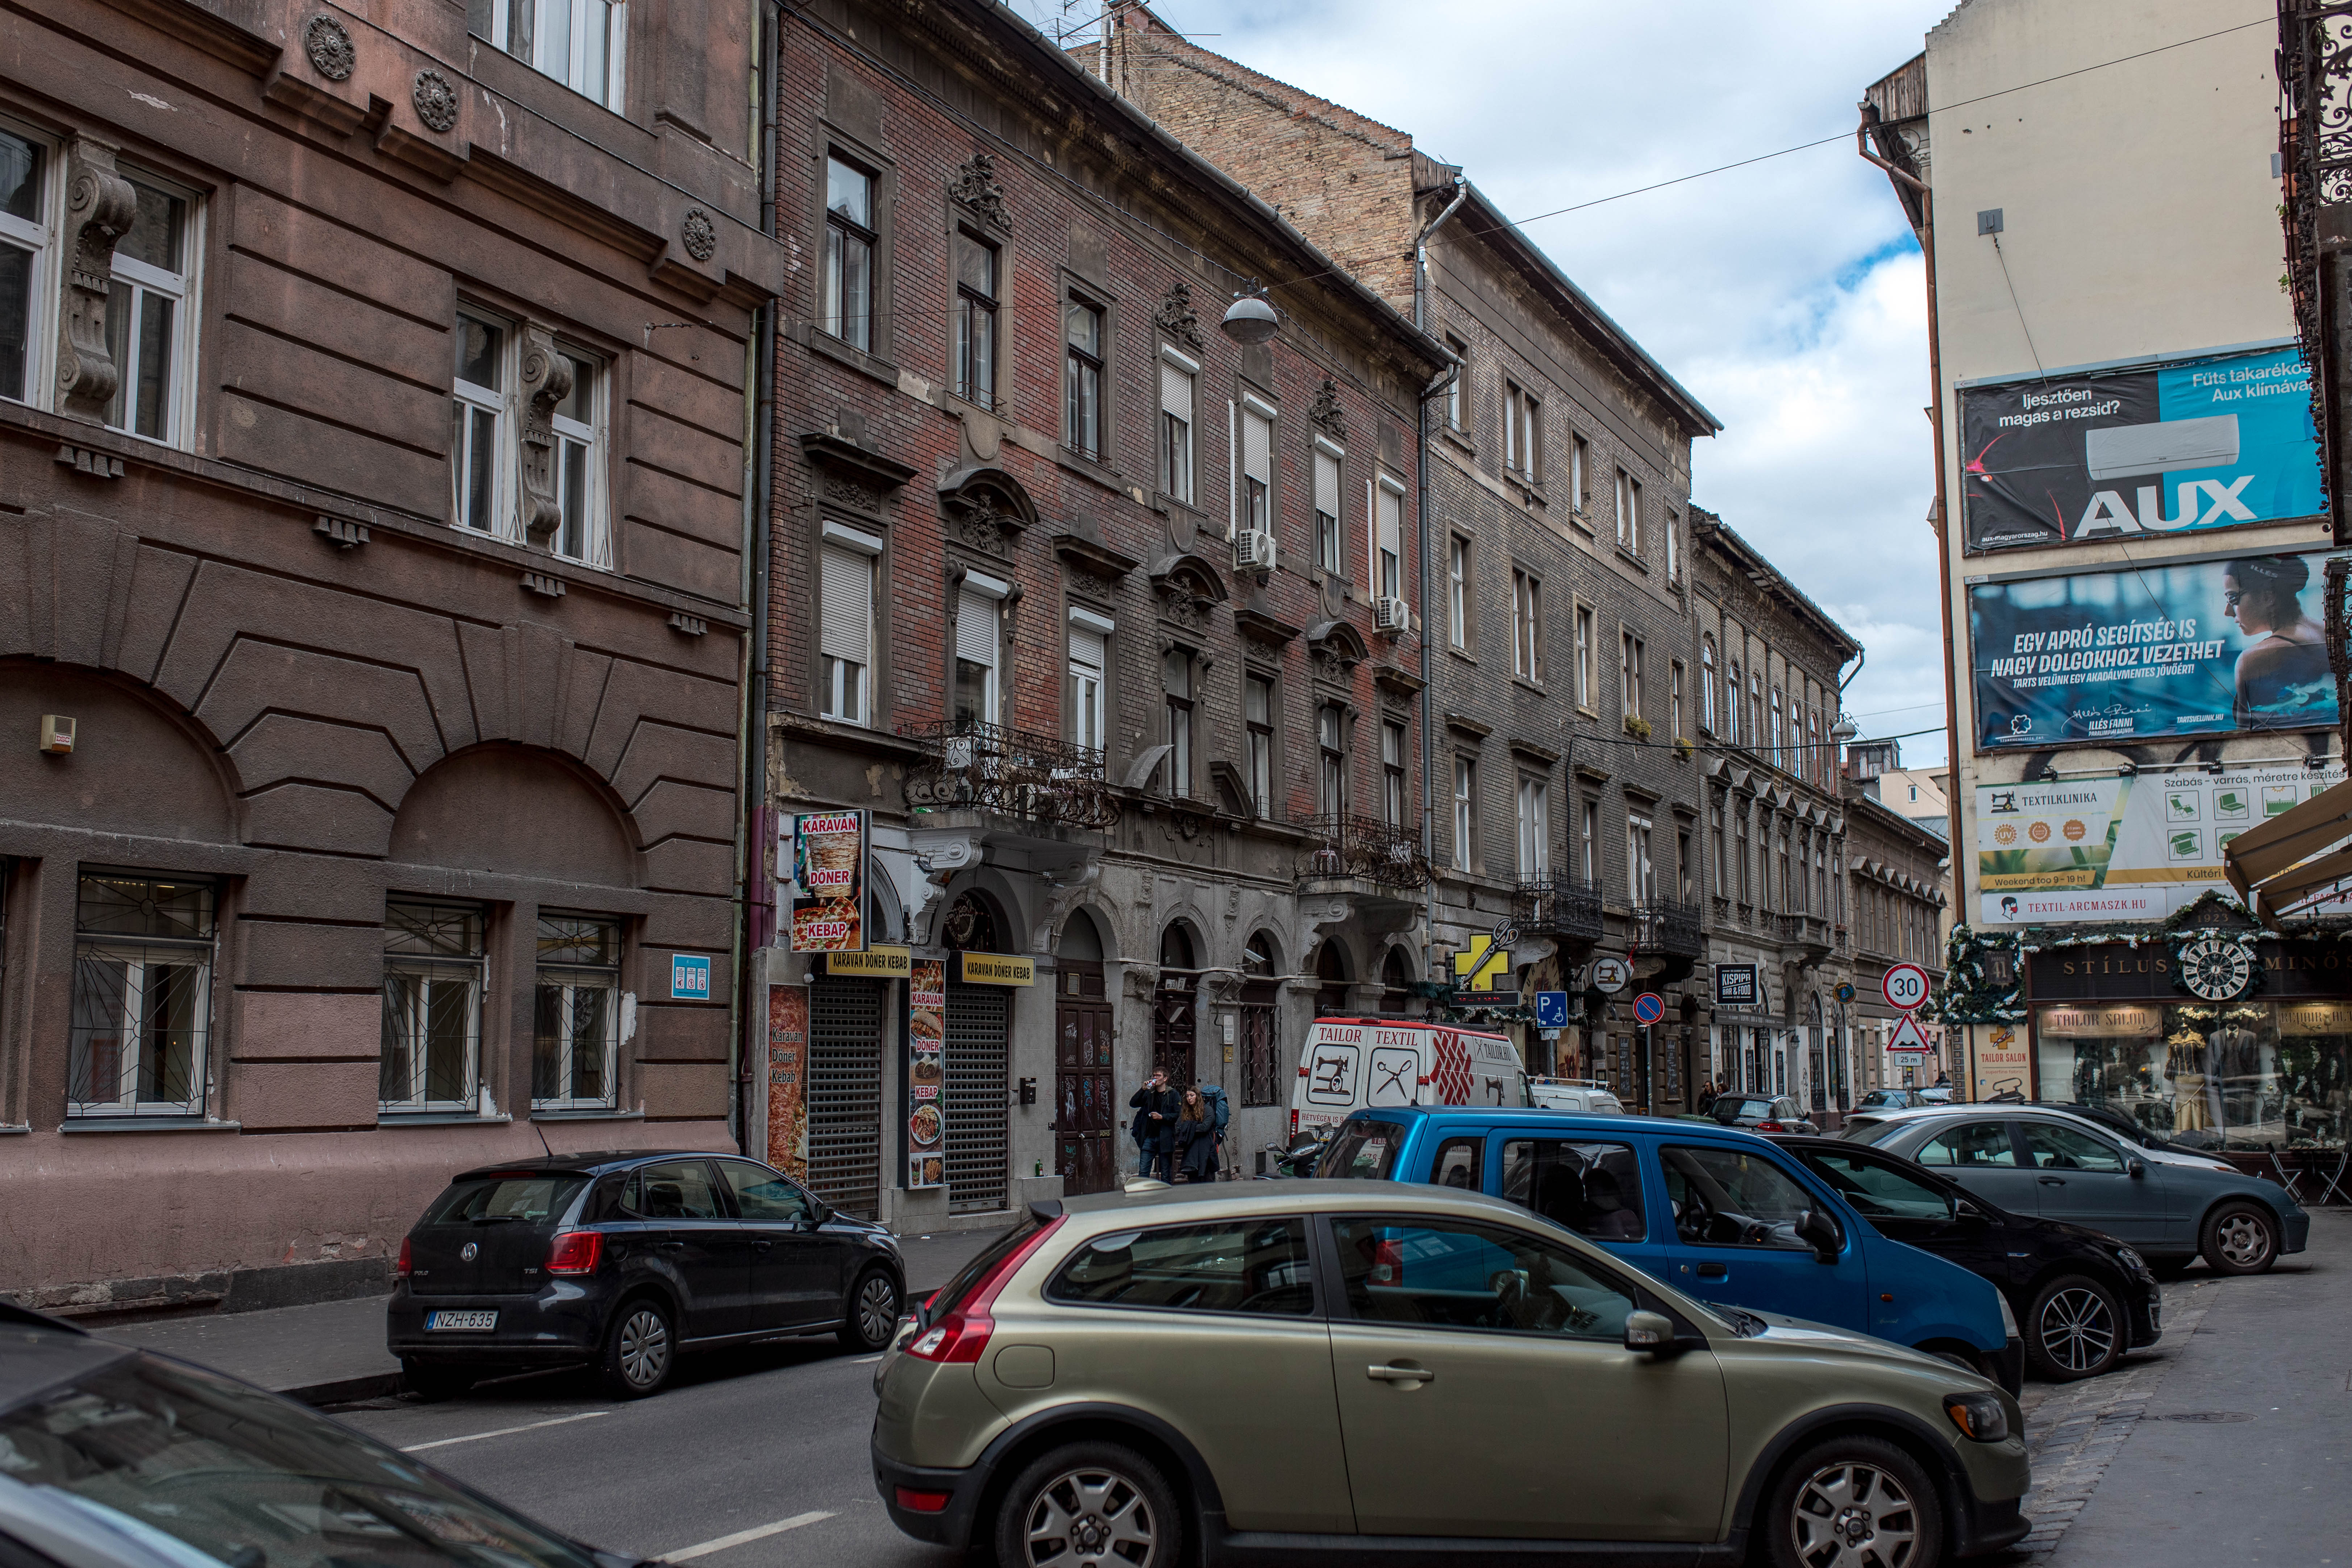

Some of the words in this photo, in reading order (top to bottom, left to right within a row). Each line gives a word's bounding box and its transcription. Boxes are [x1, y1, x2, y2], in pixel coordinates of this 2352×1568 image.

[2193, 372, 2226, 387] Fűts
[2212, 388, 2242, 402] Aux
[2247, 379, 2313, 398] klímáva
[2023, 388, 2091, 409] Ijesztően
[1999, 411, 2050, 427] magas
[2053, 410, 2062, 421] a
[2065, 400, 2120, 419] rezsid?
[2073, 475, 2257, 538] AUX
[1982, 531, 2048, 542] aux-magyarorszag.hu
[2013, 632, 2046, 653] EGY
[2047, 623, 2093, 650] APRÓ
[2096, 616, 2175, 646] SEGÍTSÉG
[2177, 618, 2196, 639] IS
[1991, 656, 2037, 677] NAGY
[2039, 647, 2140, 674] DOLGOKHOZ
[2143, 639, 2225, 664] VEZETHET
[2013, 677, 2037, 689] TARTS
[2038, 673, 2069, 687] VELÜNK
[2070, 673, 2086, 684] EGY
[2086, 668, 2155, 683] AKADÁLYMENTES
[2156, 664, 2195, 679] JÖVŐÉRT!
[2089, 718, 2108, 731] ILLÉS
[2109, 717, 2133, 729] FANNI
[2177, 713, 2224, 724] TARTSVELUNK.HU
[2164, 776, 2203, 787] Szabás
[2213, 775, 2251, 785] varrás,
[2253, 772, 2298, 783] méretre
[2301, 770, 2345, 780] készítés
[2022, 792, 2097, 806] TEXTILKLINIKA
[803, 817, 856, 833] KARAVAN
[810, 869, 849, 885] DÖNER
[2187, 868, 2221, 879] Kültéri
[1995, 877, 2035, 886] Weekend
[2028, 899, 2146, 913] TEXTIL-ARCMASZK.HU
[2197, 913, 2229, 923] 1923
[808, 923, 846, 937] KEBAP
[833, 953, 863, 968] KARAVAN
[865, 950, 886, 968] DÖNER
[888, 955, 907, 970] KEBAB
[2064, 956, 2168, 975] STÍLUS
[967, 961, 992, 977] KARAVAN
[994, 961, 1012, 978] DÖNER
[1013, 966, 1030, 980] KEBAB
[1990, 961, 2006, 978] 41
[1722, 973, 1751, 986] KISPIPA
[1723, 987, 1732, 995] BAR
[1733, 987, 1737, 995] &
[1738, 984, 1751, 995] FOOD
[1894, 978, 1918, 996] 30
[912, 993, 943, 1006] KARAVAN
[1541, 997, 1550, 1012] P
[2054, 1013, 2099, 1026] TAILOR
[2106, 1012, 2145, 1026] SALON
[773, 1028, 803, 1042] Karavan
[1319, 1027, 1362, 1043] TAILOR
[1376, 1031, 1418, 1046] TEXTIL
[917, 1039, 939, 1051] DÖNER
[1484, 1043, 1511, 1061] TAILOR.HU
[772, 1048, 795, 1062] Döner
[1981, 1053, 2003, 1062] TAILOR
[2006, 1053, 2026, 1062] SALON
[772, 1069, 795, 1083] Kebab
[916, 1087, 937, 1098] KEBAP
[1302, 1113, 1331, 1123] HÉTVÉGÉN
[435, 1312, 494, 1327] NZH-635
